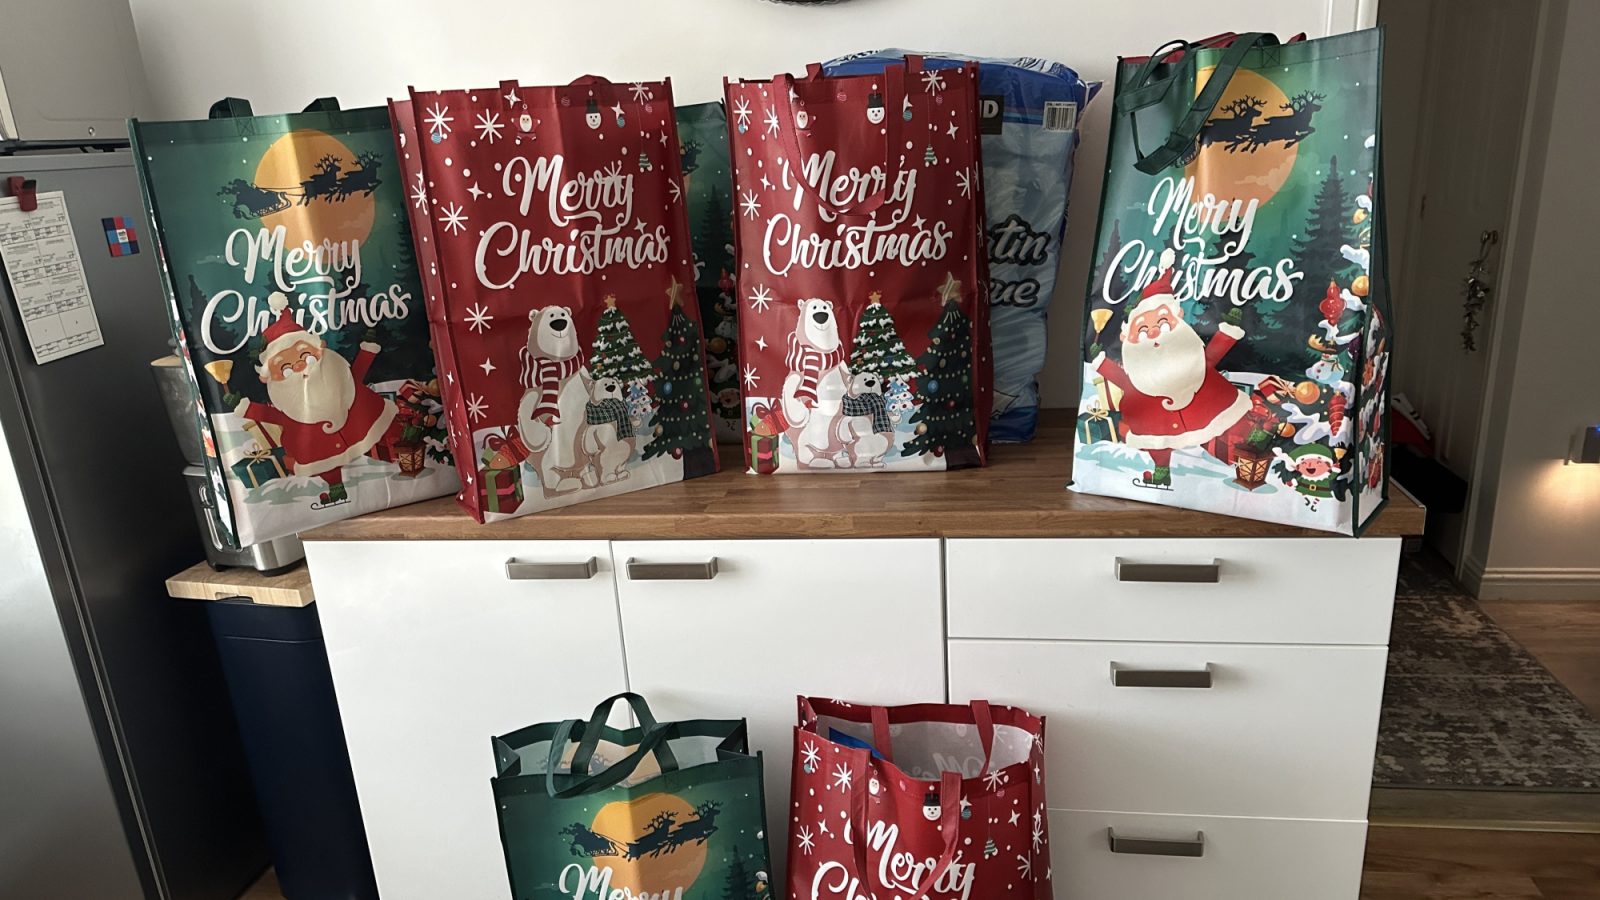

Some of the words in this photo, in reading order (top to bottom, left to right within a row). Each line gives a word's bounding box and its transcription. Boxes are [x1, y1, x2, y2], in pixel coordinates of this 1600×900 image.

[502, 154, 634, 228] Merry
[1147, 175, 1259, 256] Mery
[225, 224, 362, 293] Merry
[475, 221, 671, 290] Christmas
[763, 213, 953, 276] Christmas
[990, 279, 1039, 306] ue
